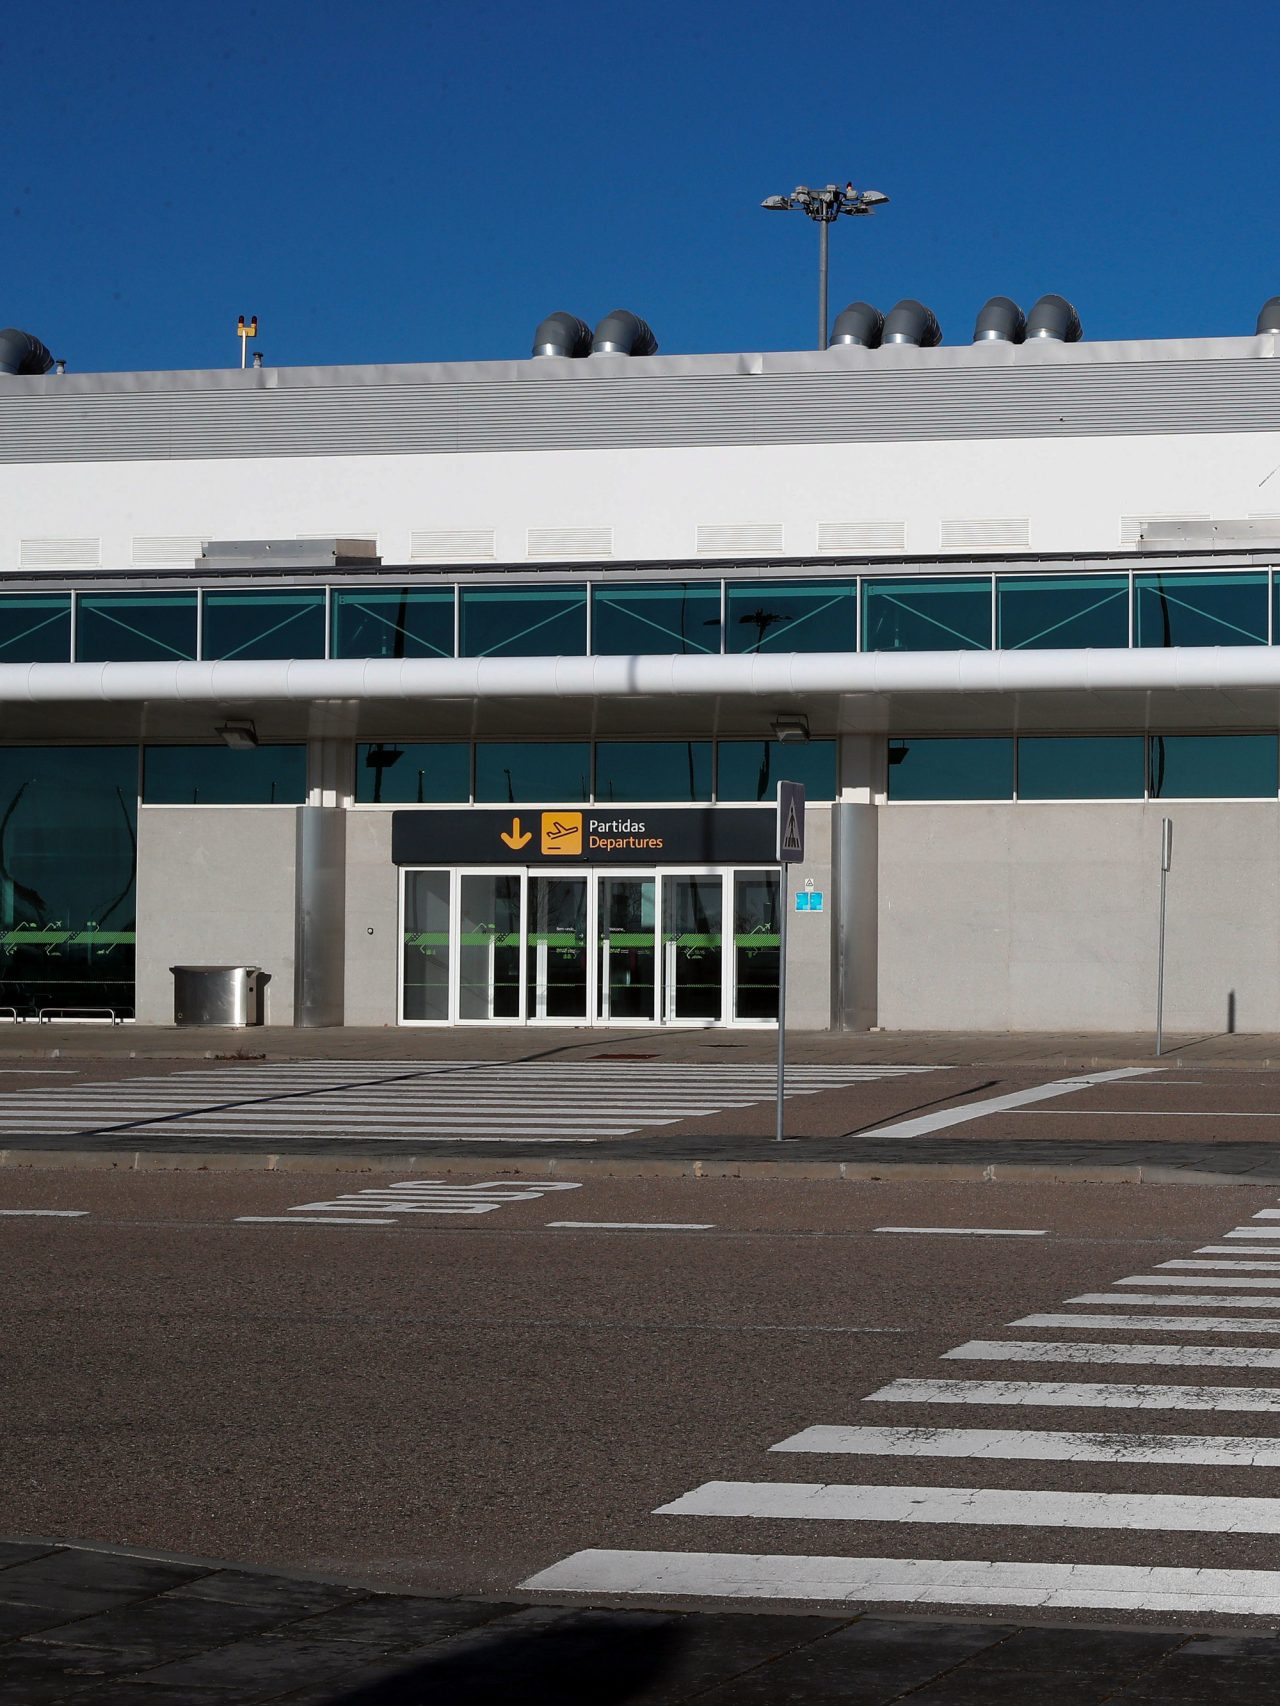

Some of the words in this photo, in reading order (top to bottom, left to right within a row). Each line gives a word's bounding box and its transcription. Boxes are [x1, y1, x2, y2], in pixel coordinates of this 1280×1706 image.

[589, 818, 646, 833] Partidas
[589, 835, 663, 852] Departures
[288, 1180, 583, 1213] BUS
